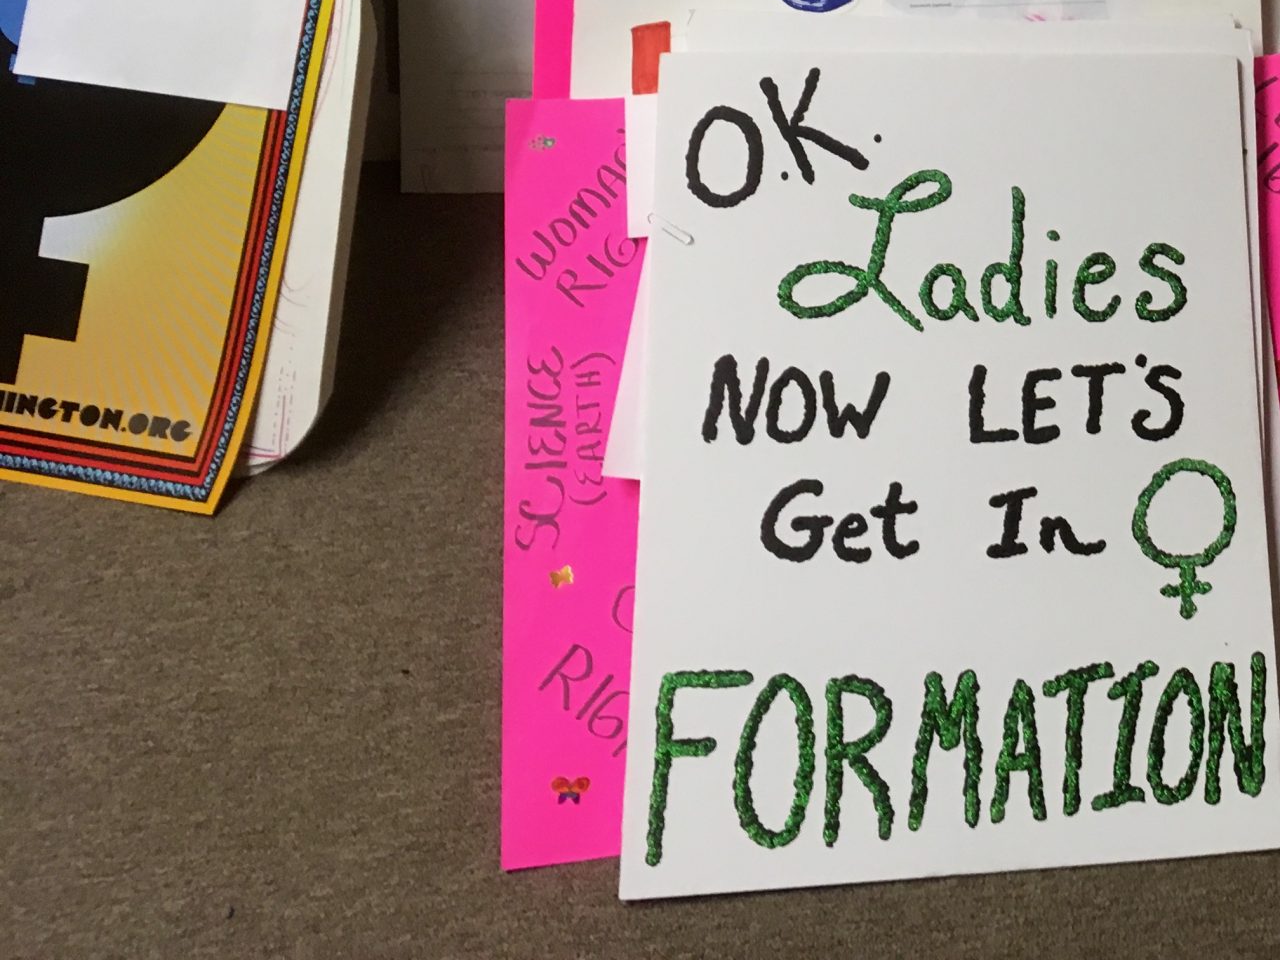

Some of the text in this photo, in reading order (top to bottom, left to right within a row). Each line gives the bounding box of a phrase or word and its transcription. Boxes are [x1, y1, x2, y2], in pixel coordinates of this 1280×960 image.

[776, 169, 1188, 332] Ladies
[514, 344, 568, 552] SCIENCE
[701, 352, 1184, 445] NOW LET'S
[759, 478, 1107, 564] Get In
[645, 651, 1266, 868] FORMATION
